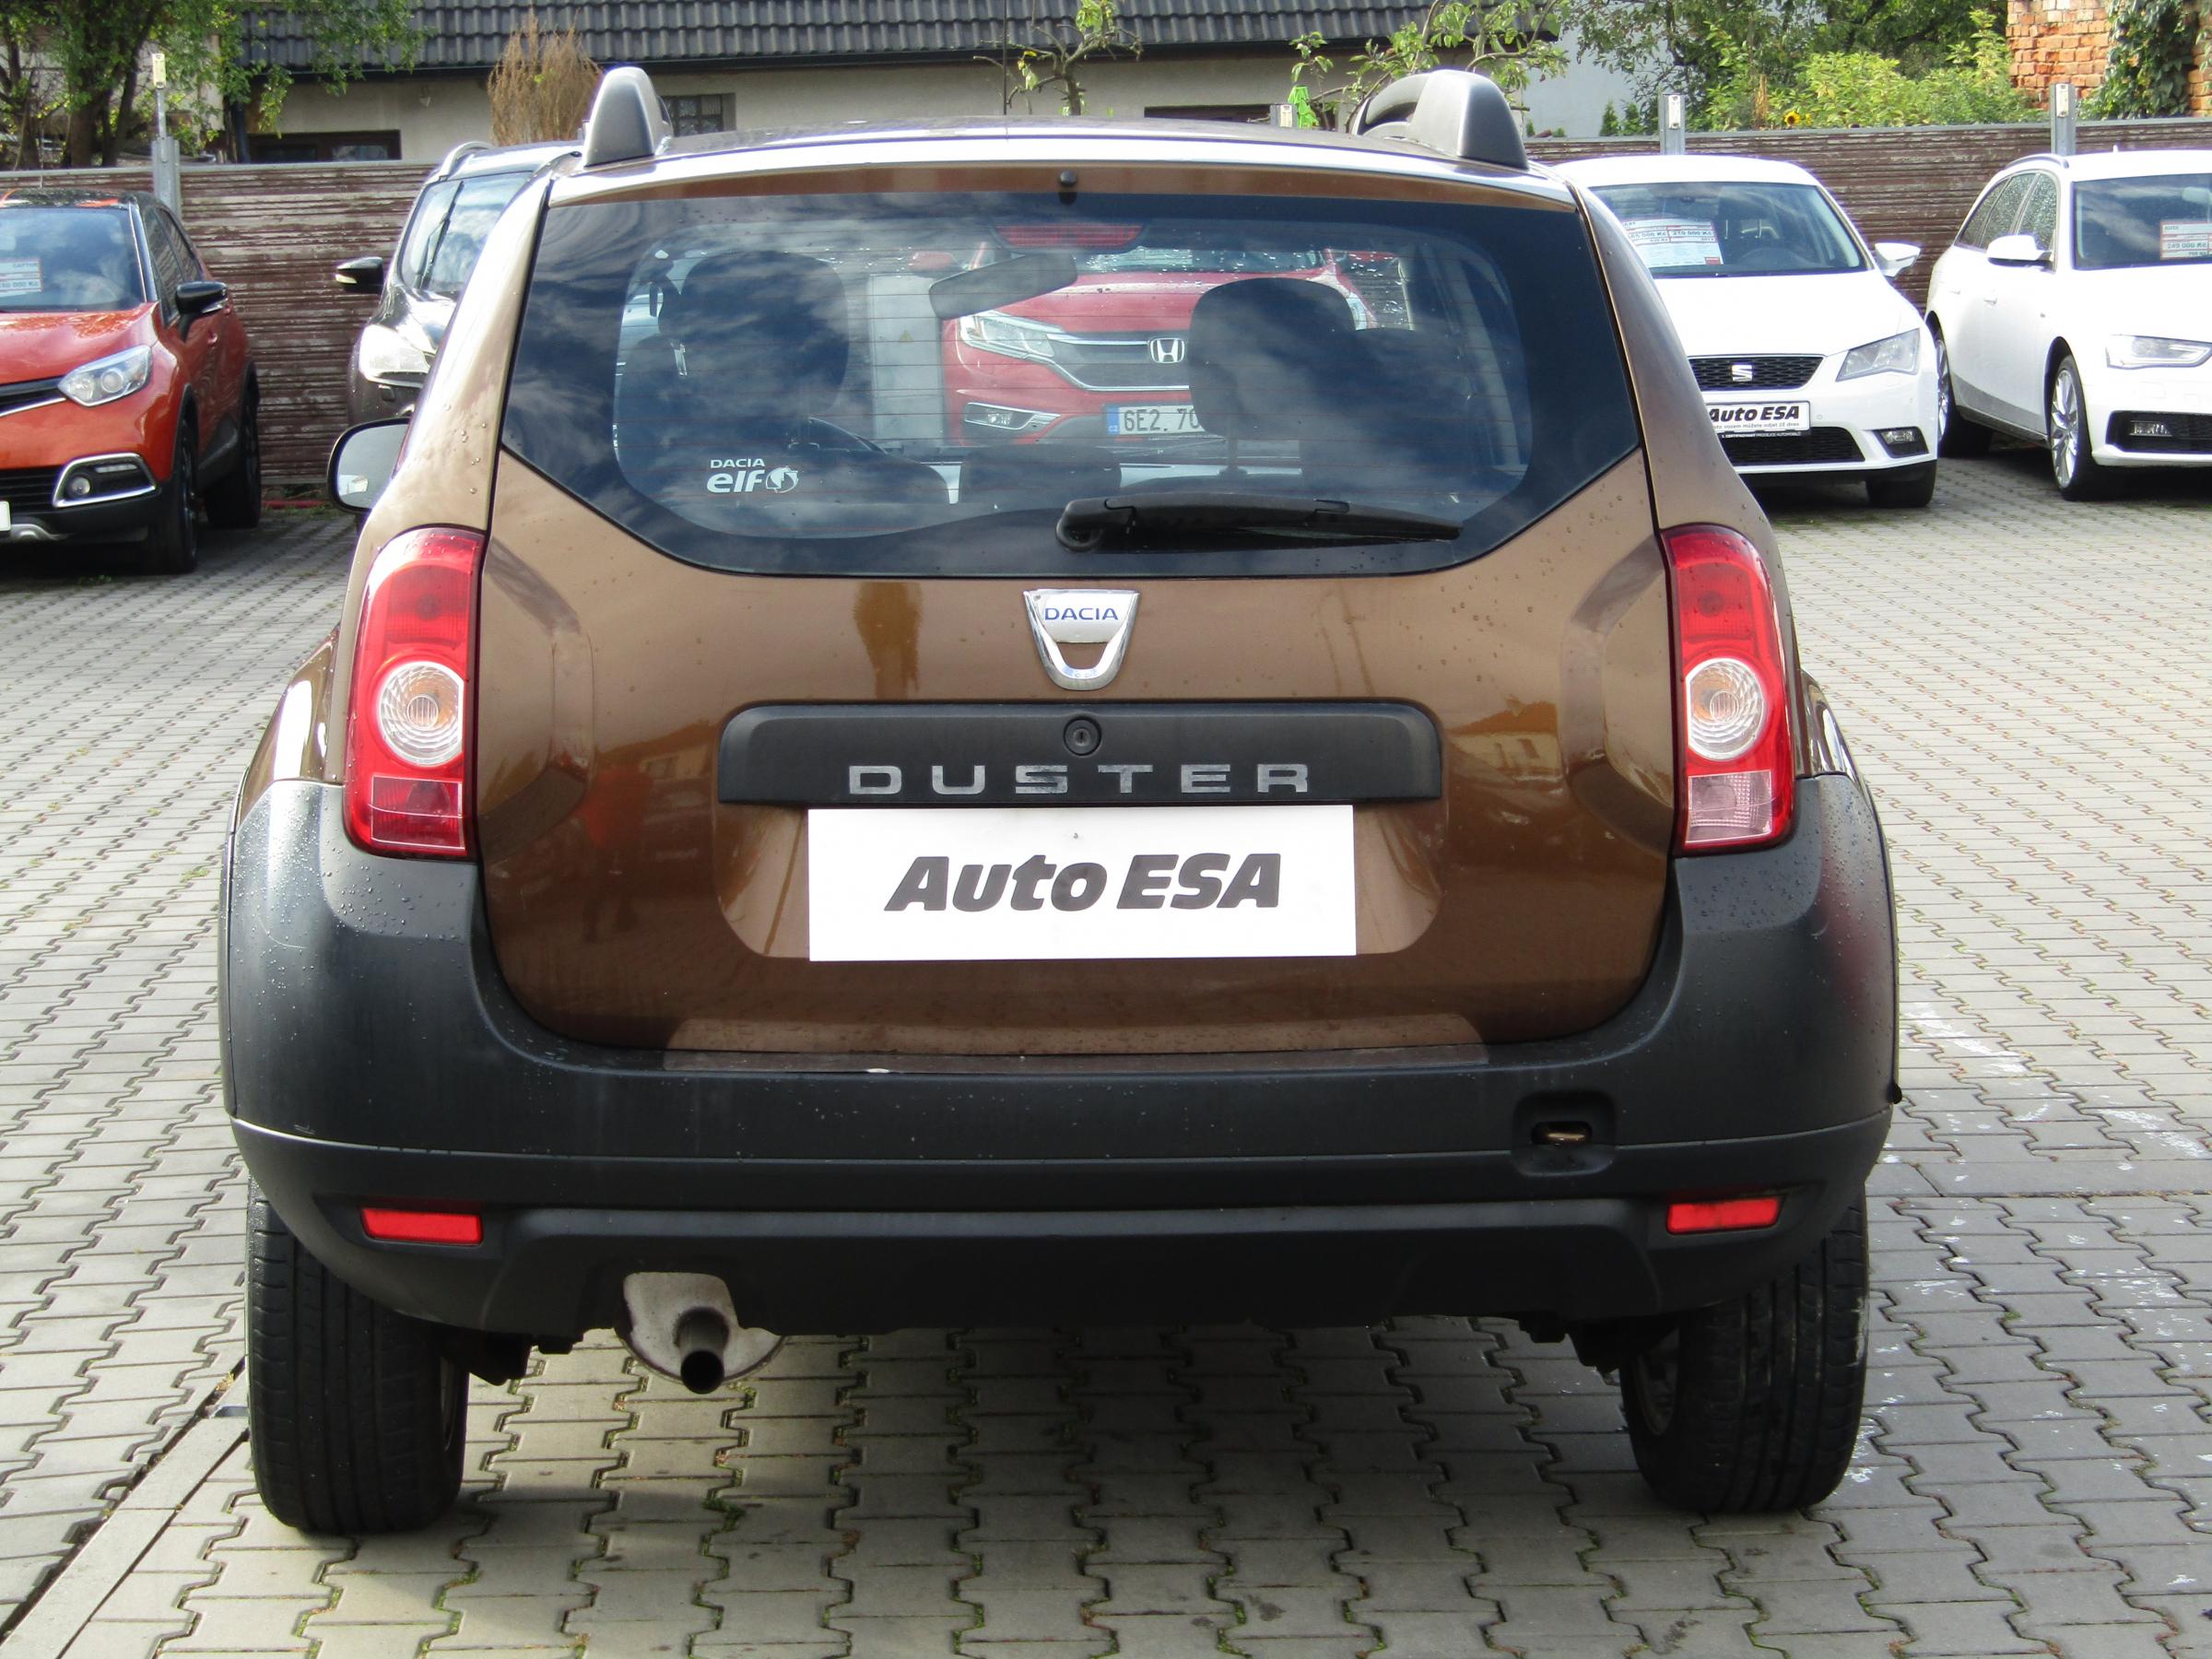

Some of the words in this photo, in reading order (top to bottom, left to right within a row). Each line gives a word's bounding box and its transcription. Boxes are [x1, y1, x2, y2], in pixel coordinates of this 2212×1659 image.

[1709, 407, 1759, 422] Auto
[1760, 406, 1799, 420] ESA
[710, 458, 766, 469] DACIA
[706, 469, 766, 494] elf
[1044, 607, 1119, 620] DACIA
[848, 763, 1309, 795] DUSTER
[883, 853, 1109, 912] Auto
[1115, 853, 1282, 911] ESA
